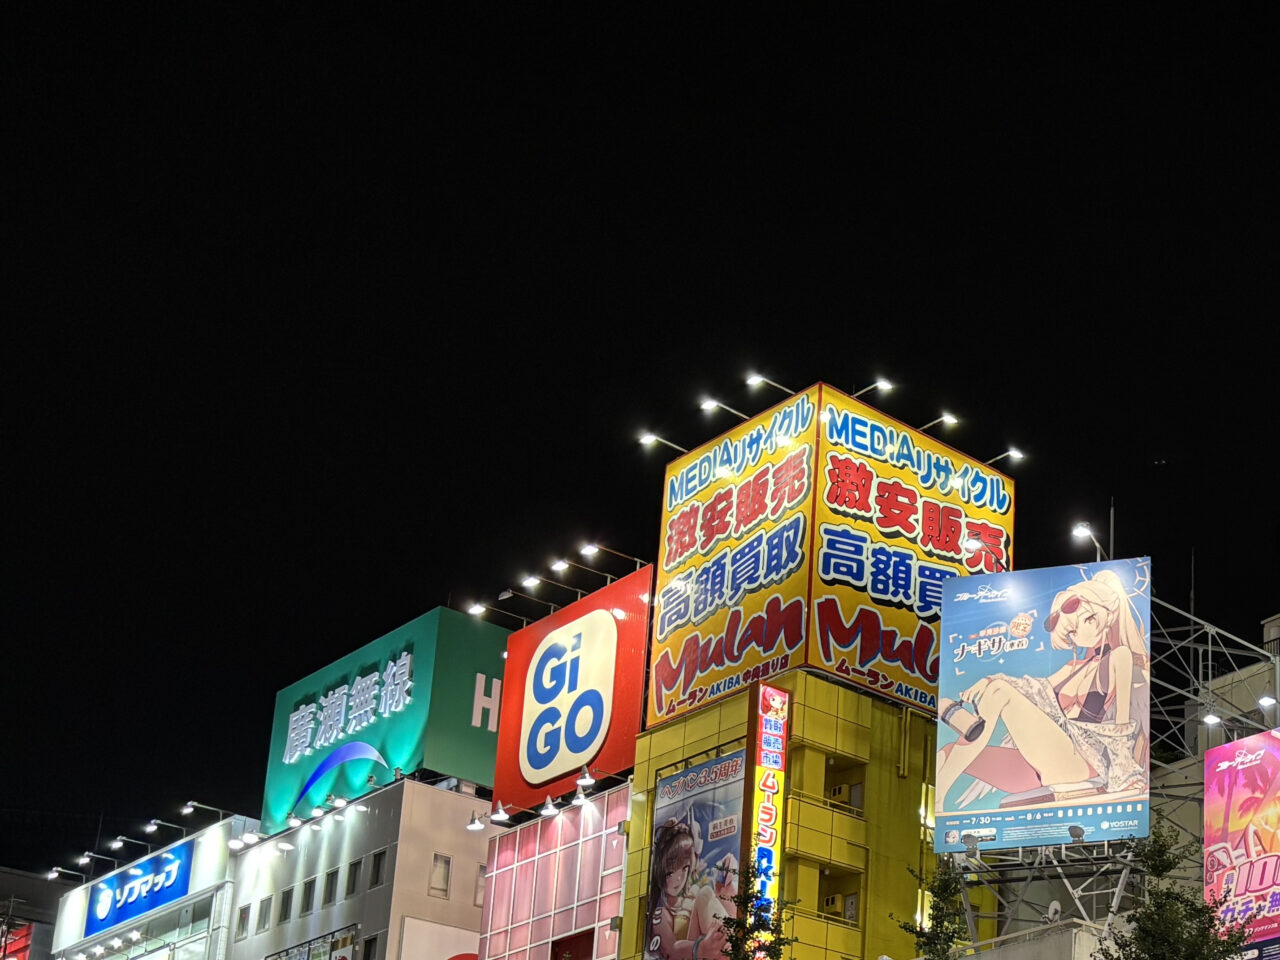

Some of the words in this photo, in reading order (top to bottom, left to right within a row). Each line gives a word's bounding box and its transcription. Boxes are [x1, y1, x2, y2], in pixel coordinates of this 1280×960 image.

[667, 393, 813, 511] MEDIAリサイクル
[826, 405, 1010, 514] MEDIAリサイクル
[664, 445, 812, 568] 激安販売
[826, 453, 1007, 573] 激安販売
[656, 515, 807, 641] 高額買取
[819, 523, 944, 622] 高額買
[652, 596, 806, 717] Mulan
[761, 717, 784, 736] 買取
[761, 734, 784, 751] 販売
[757, 770, 779, 848] ムーラン
[1110, 819, 1139, 828] YOSTAR
[115, 859, 182, 909] ソフマップ
